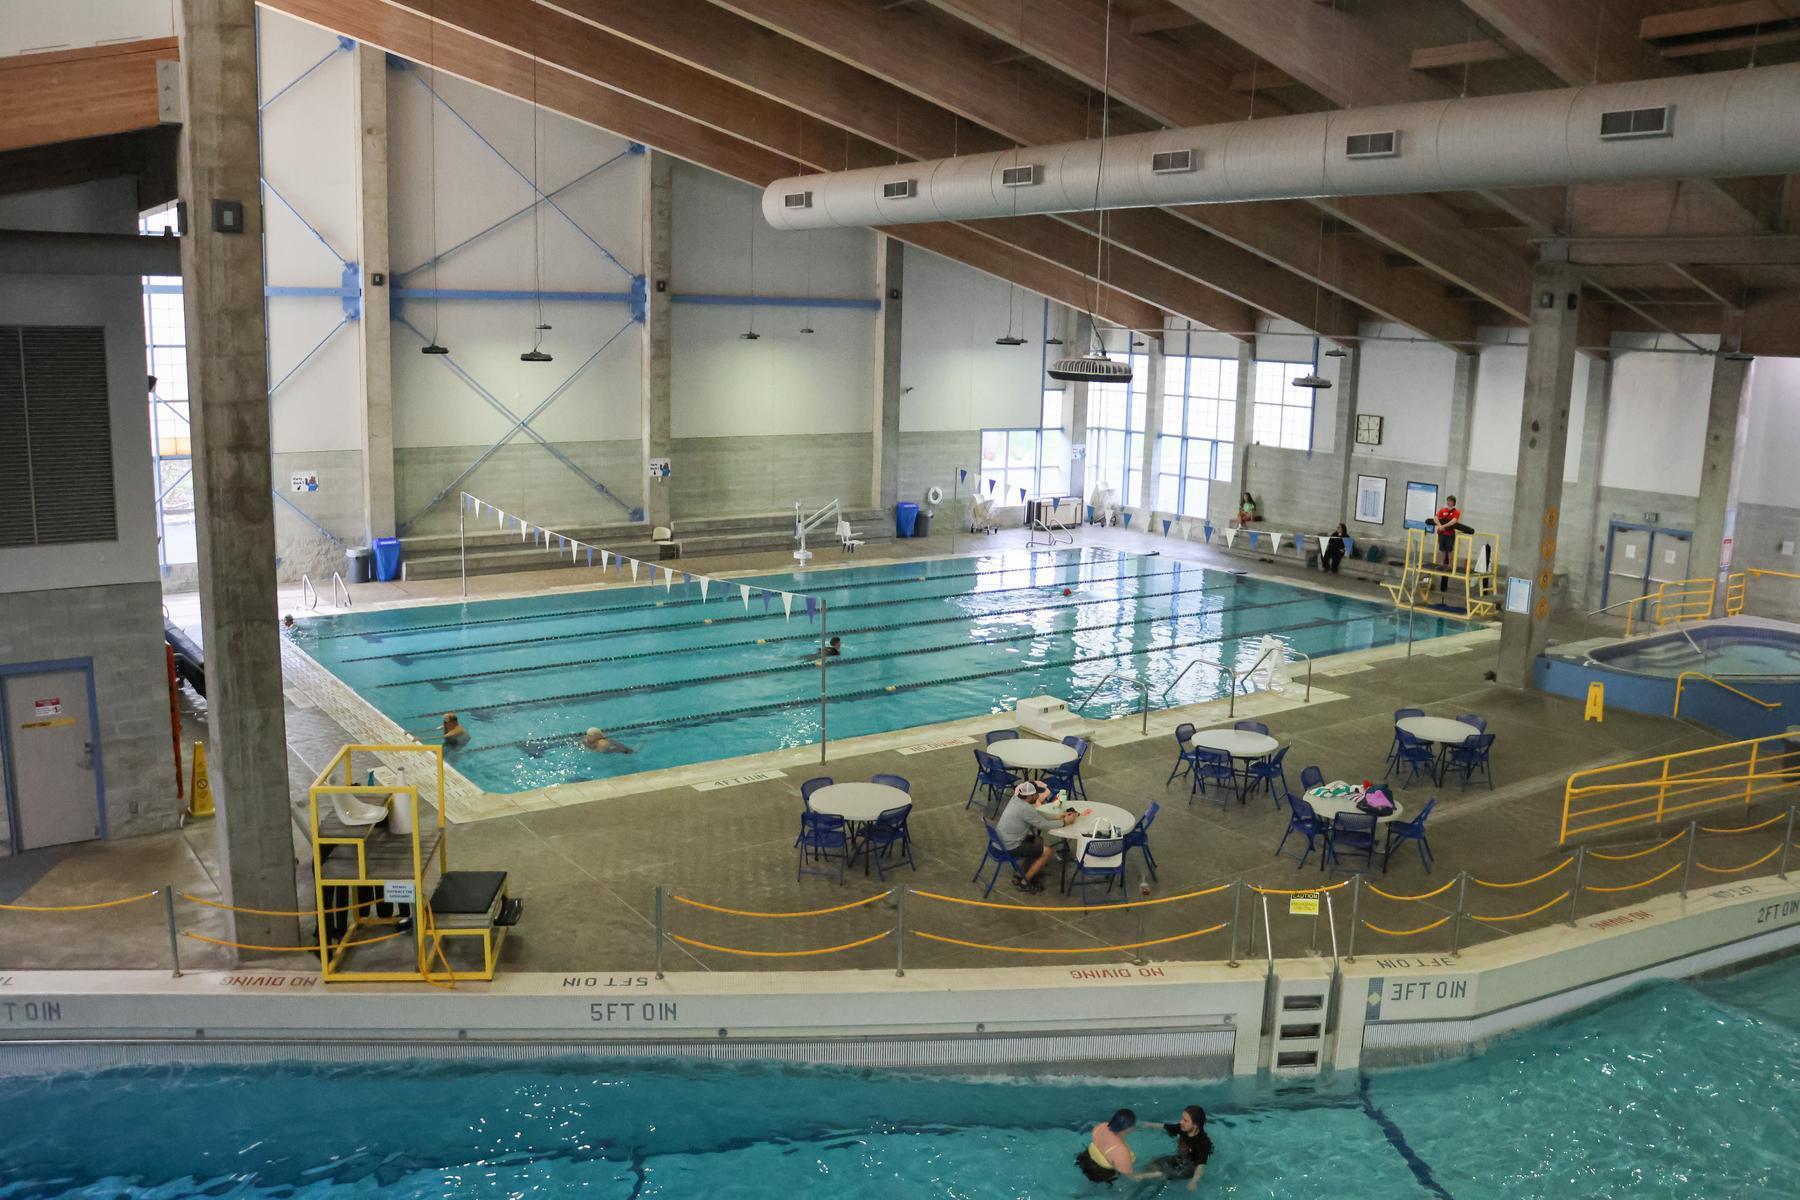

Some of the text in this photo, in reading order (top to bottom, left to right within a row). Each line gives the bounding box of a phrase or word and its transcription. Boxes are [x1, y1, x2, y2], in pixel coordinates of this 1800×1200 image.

[1757, 903, 1781, 924] 2FT
[1070, 967, 1165, 979] NO DIVING
[219, 975, 318, 987] NO DIVING
[590, 1003, 635, 1021] 5FT
